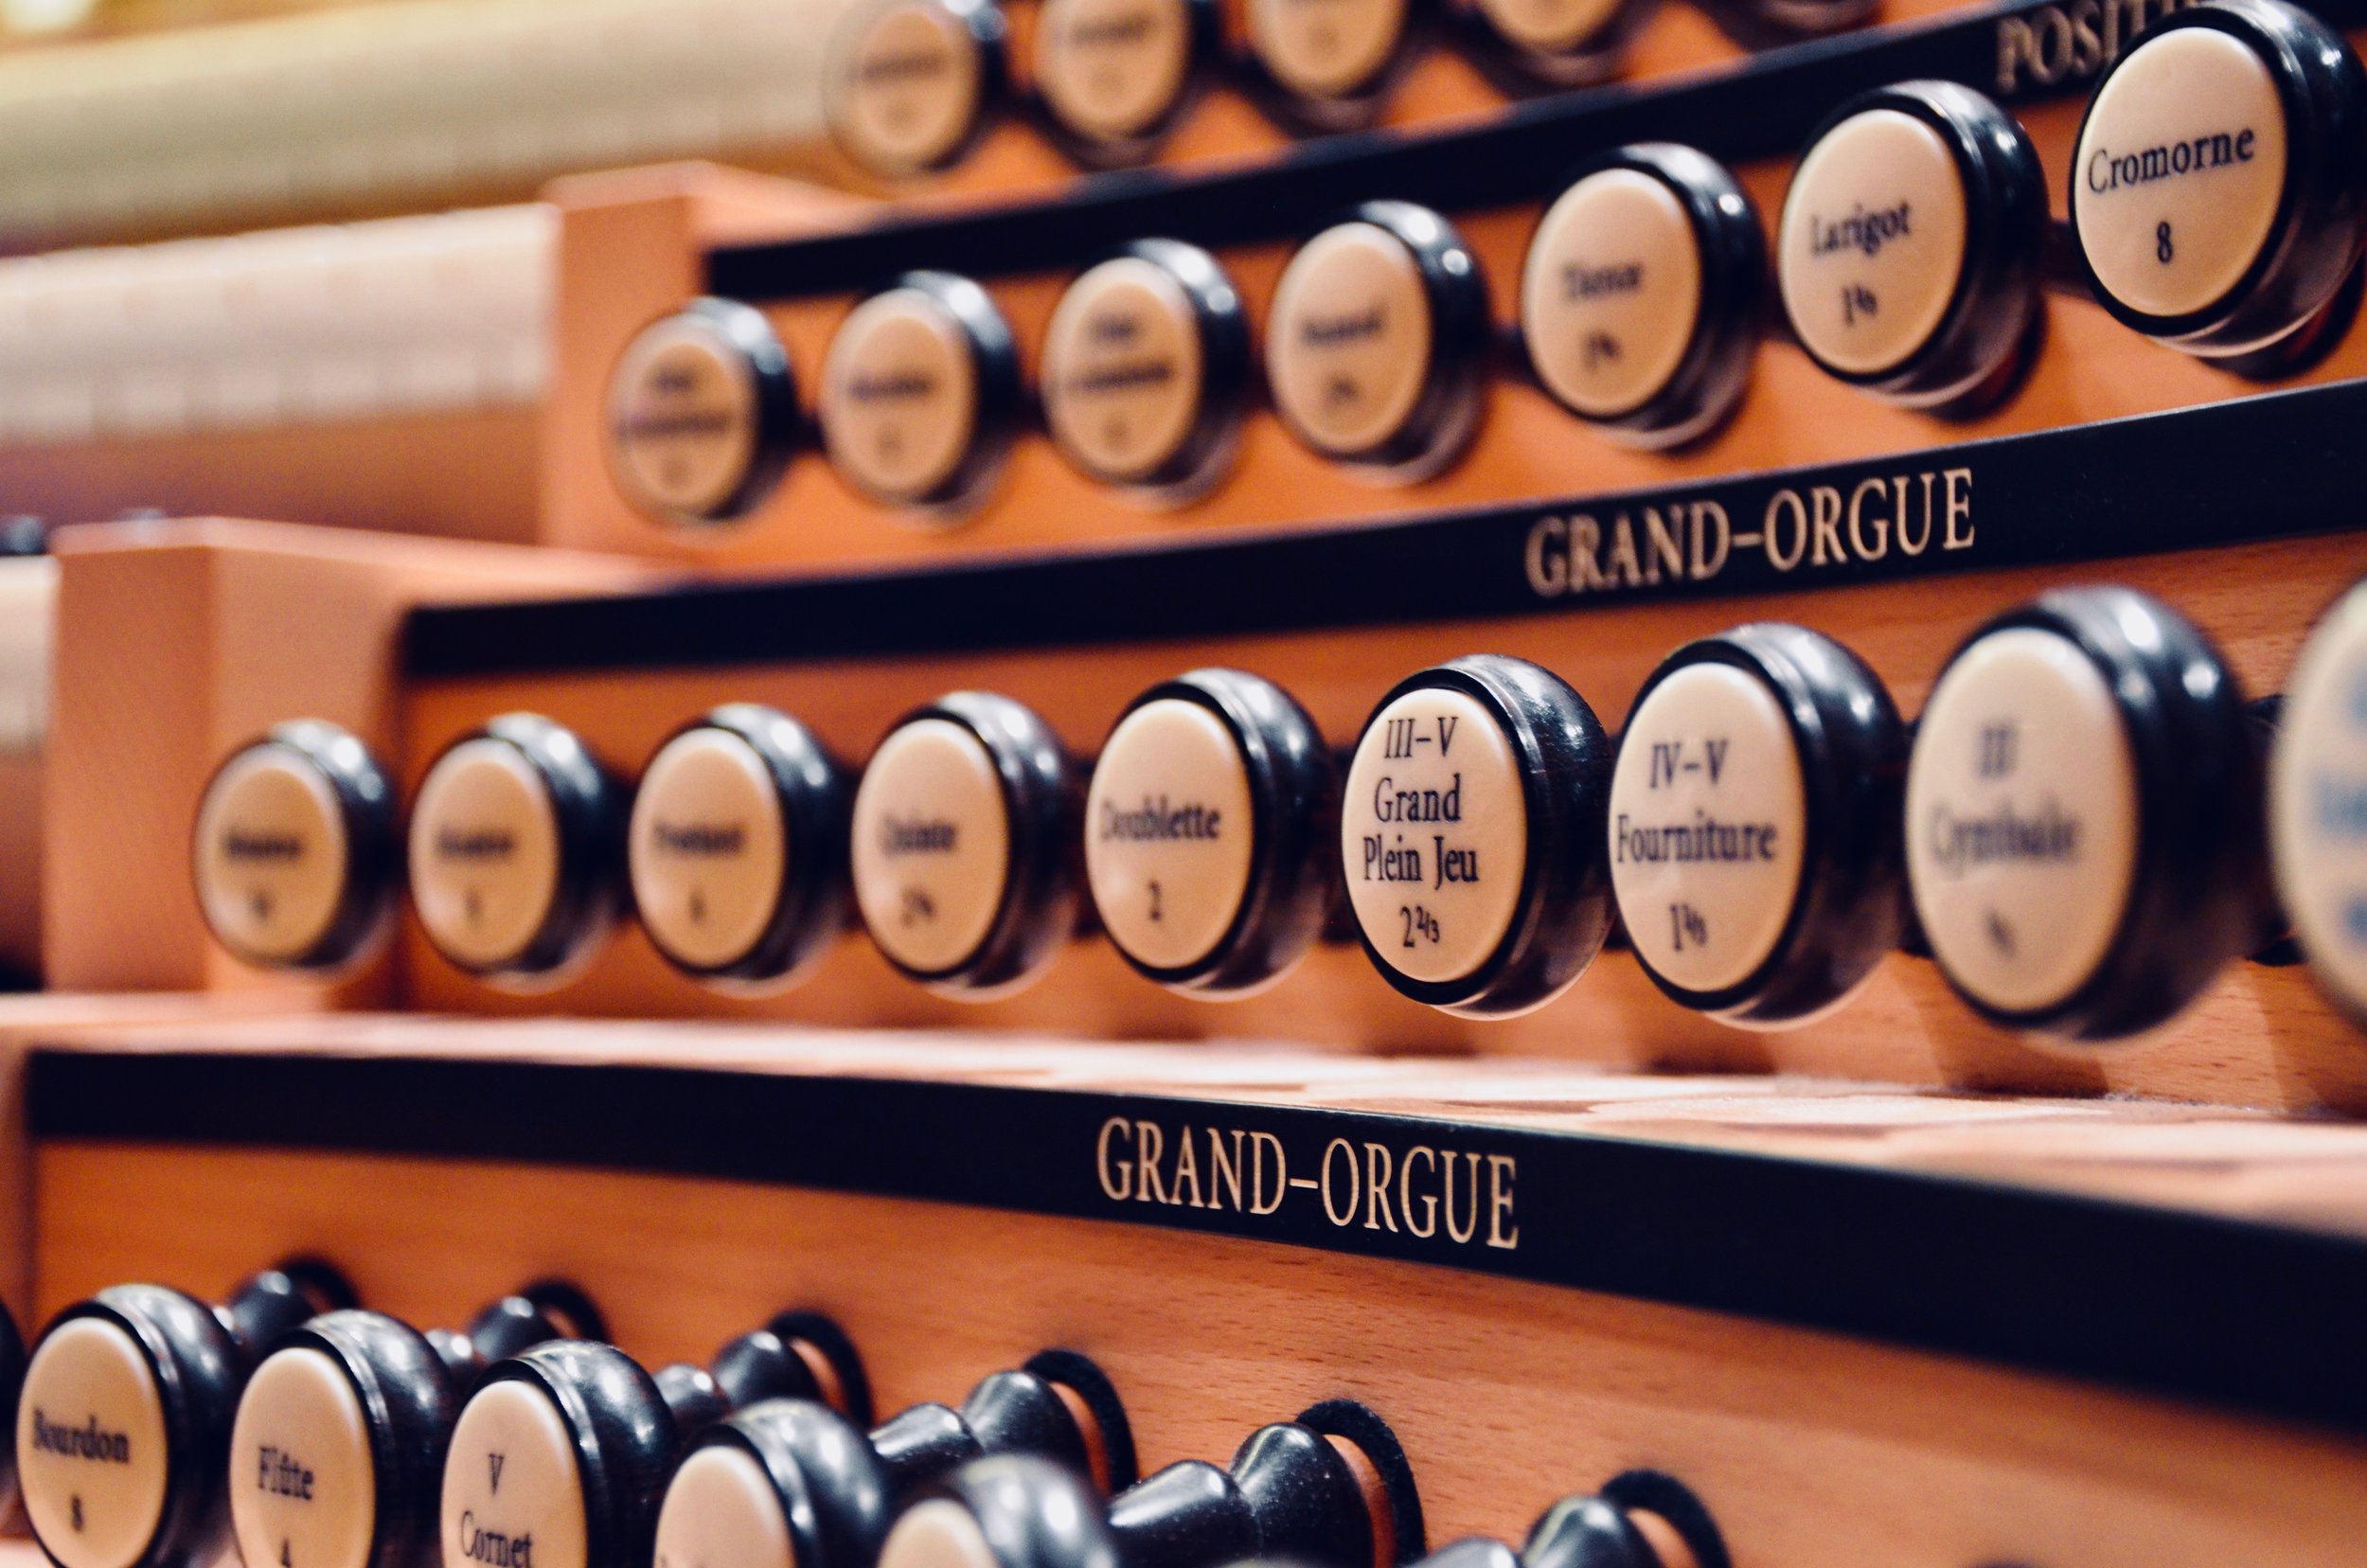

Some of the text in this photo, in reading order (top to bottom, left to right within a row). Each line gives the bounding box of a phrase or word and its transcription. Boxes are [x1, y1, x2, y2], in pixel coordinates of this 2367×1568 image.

[2088, 127, 2255, 194] Cromorne
[1810, 201, 1912, 258] Larigot
[2155, 221, 2174, 265] 8
[1101, 792, 1221, 841] Doublette
[1375, 774, 1461, 823] Grand
[1363, 834, 1479, 890] Plein Jeu
[1617, 809, 1778, 864] Fourniture
[1147, 880, 1163, 920] 2
[32, 1407, 131, 1465] Bourdon
[488, 1453, 505, 1495] V
[461, 1510, 532, 1568] Cornet
